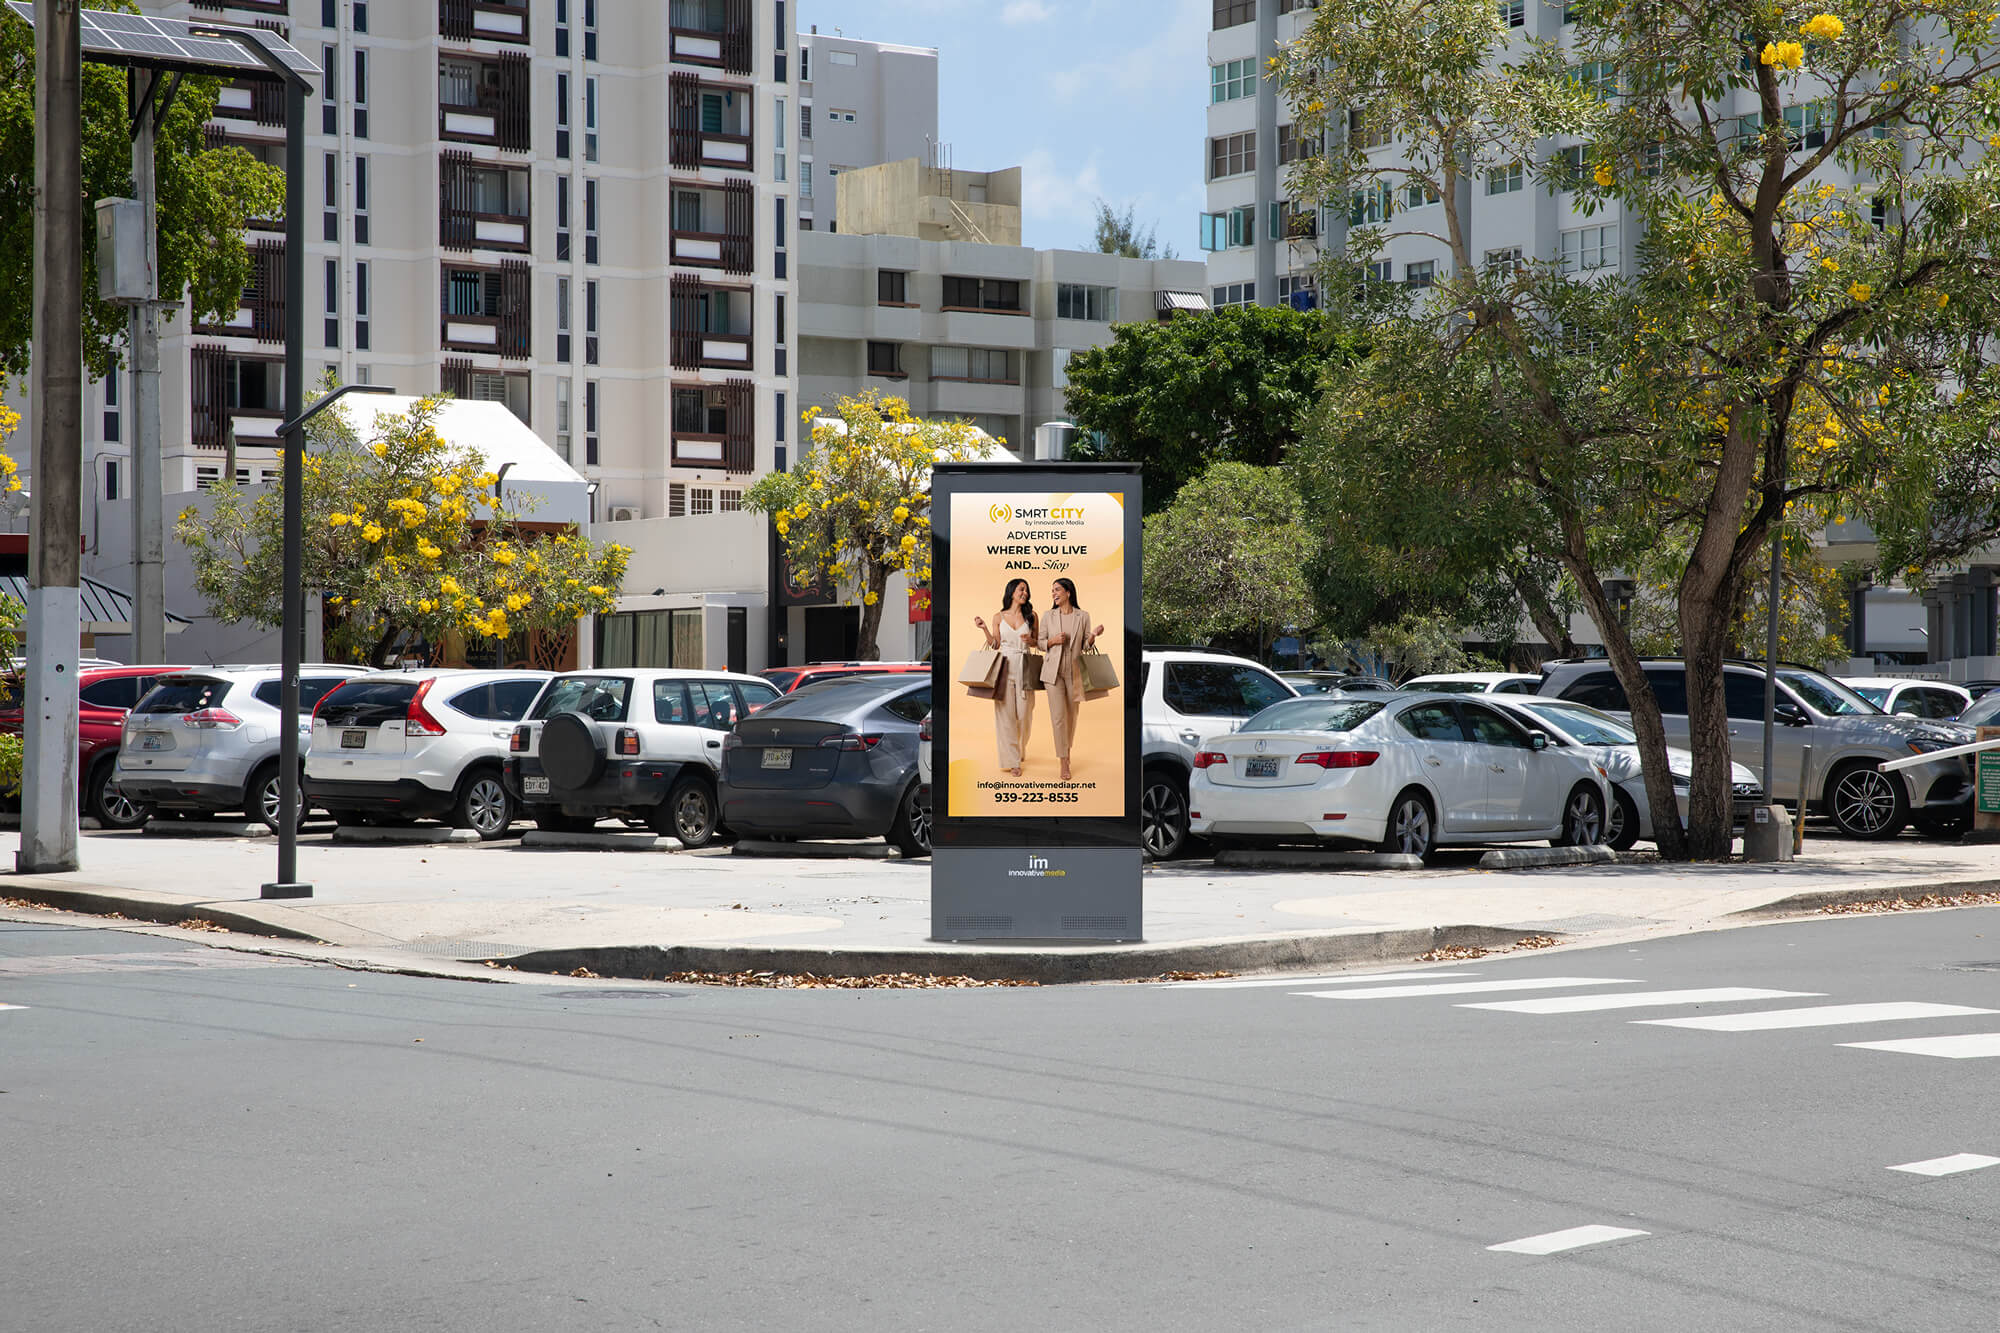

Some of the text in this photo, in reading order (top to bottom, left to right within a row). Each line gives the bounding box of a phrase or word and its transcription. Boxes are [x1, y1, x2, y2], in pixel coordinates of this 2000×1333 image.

[1015, 508, 1085, 519] SMRT CITY
[1025, 519, 1033, 527] by
[1007, 531, 1067, 540] ADVERTISE
[987, 545, 1087, 555] WHERE YOU LIVE
[1005, 559, 1070, 573] AND... Shop
[977, 781, 1096, 790] info@innovativemediapr.net
[994, 792, 1079, 803] 939-223-8535
[1008, 869, 1066, 877] innovativemedia
